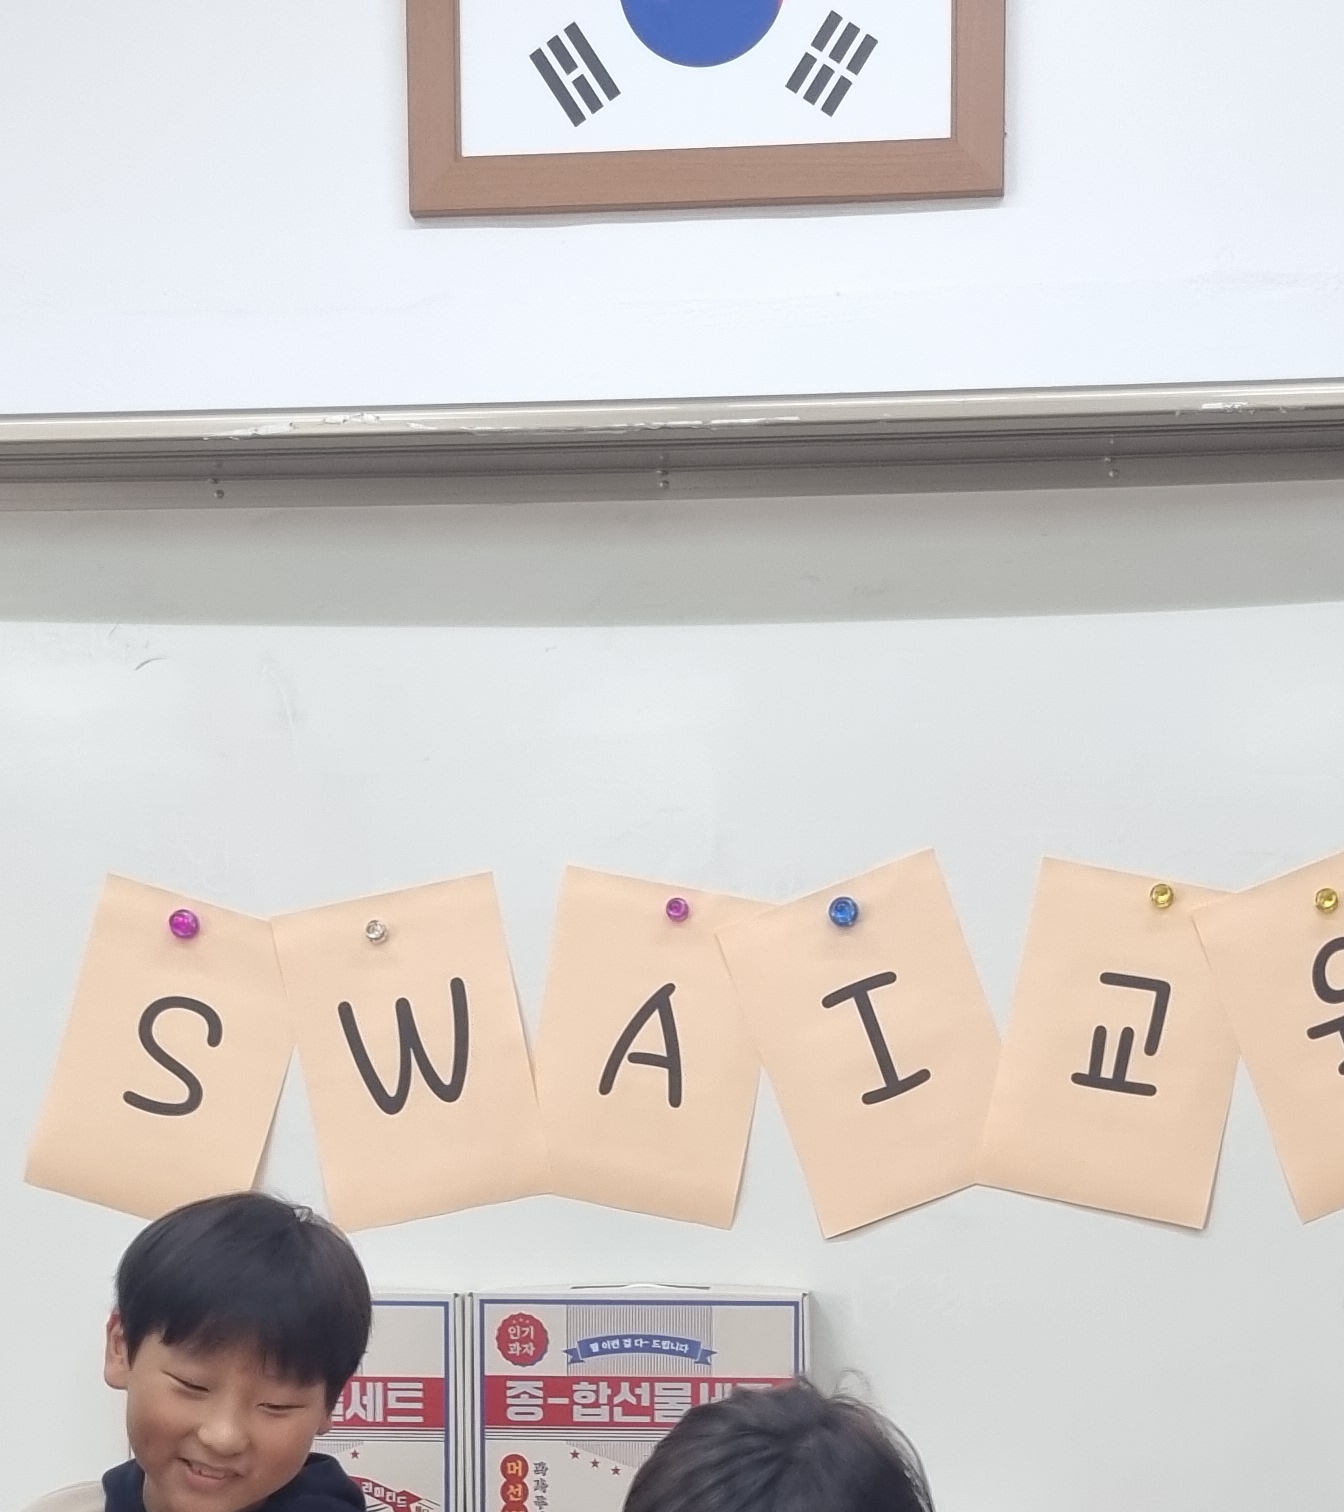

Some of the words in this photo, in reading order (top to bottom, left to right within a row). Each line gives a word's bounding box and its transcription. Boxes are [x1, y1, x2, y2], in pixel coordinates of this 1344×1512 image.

[507, 1324, 536, 1341] 인기
[507, 1341, 537, 1357] 과자
[651, 1339, 690, 1354] 드립니다
